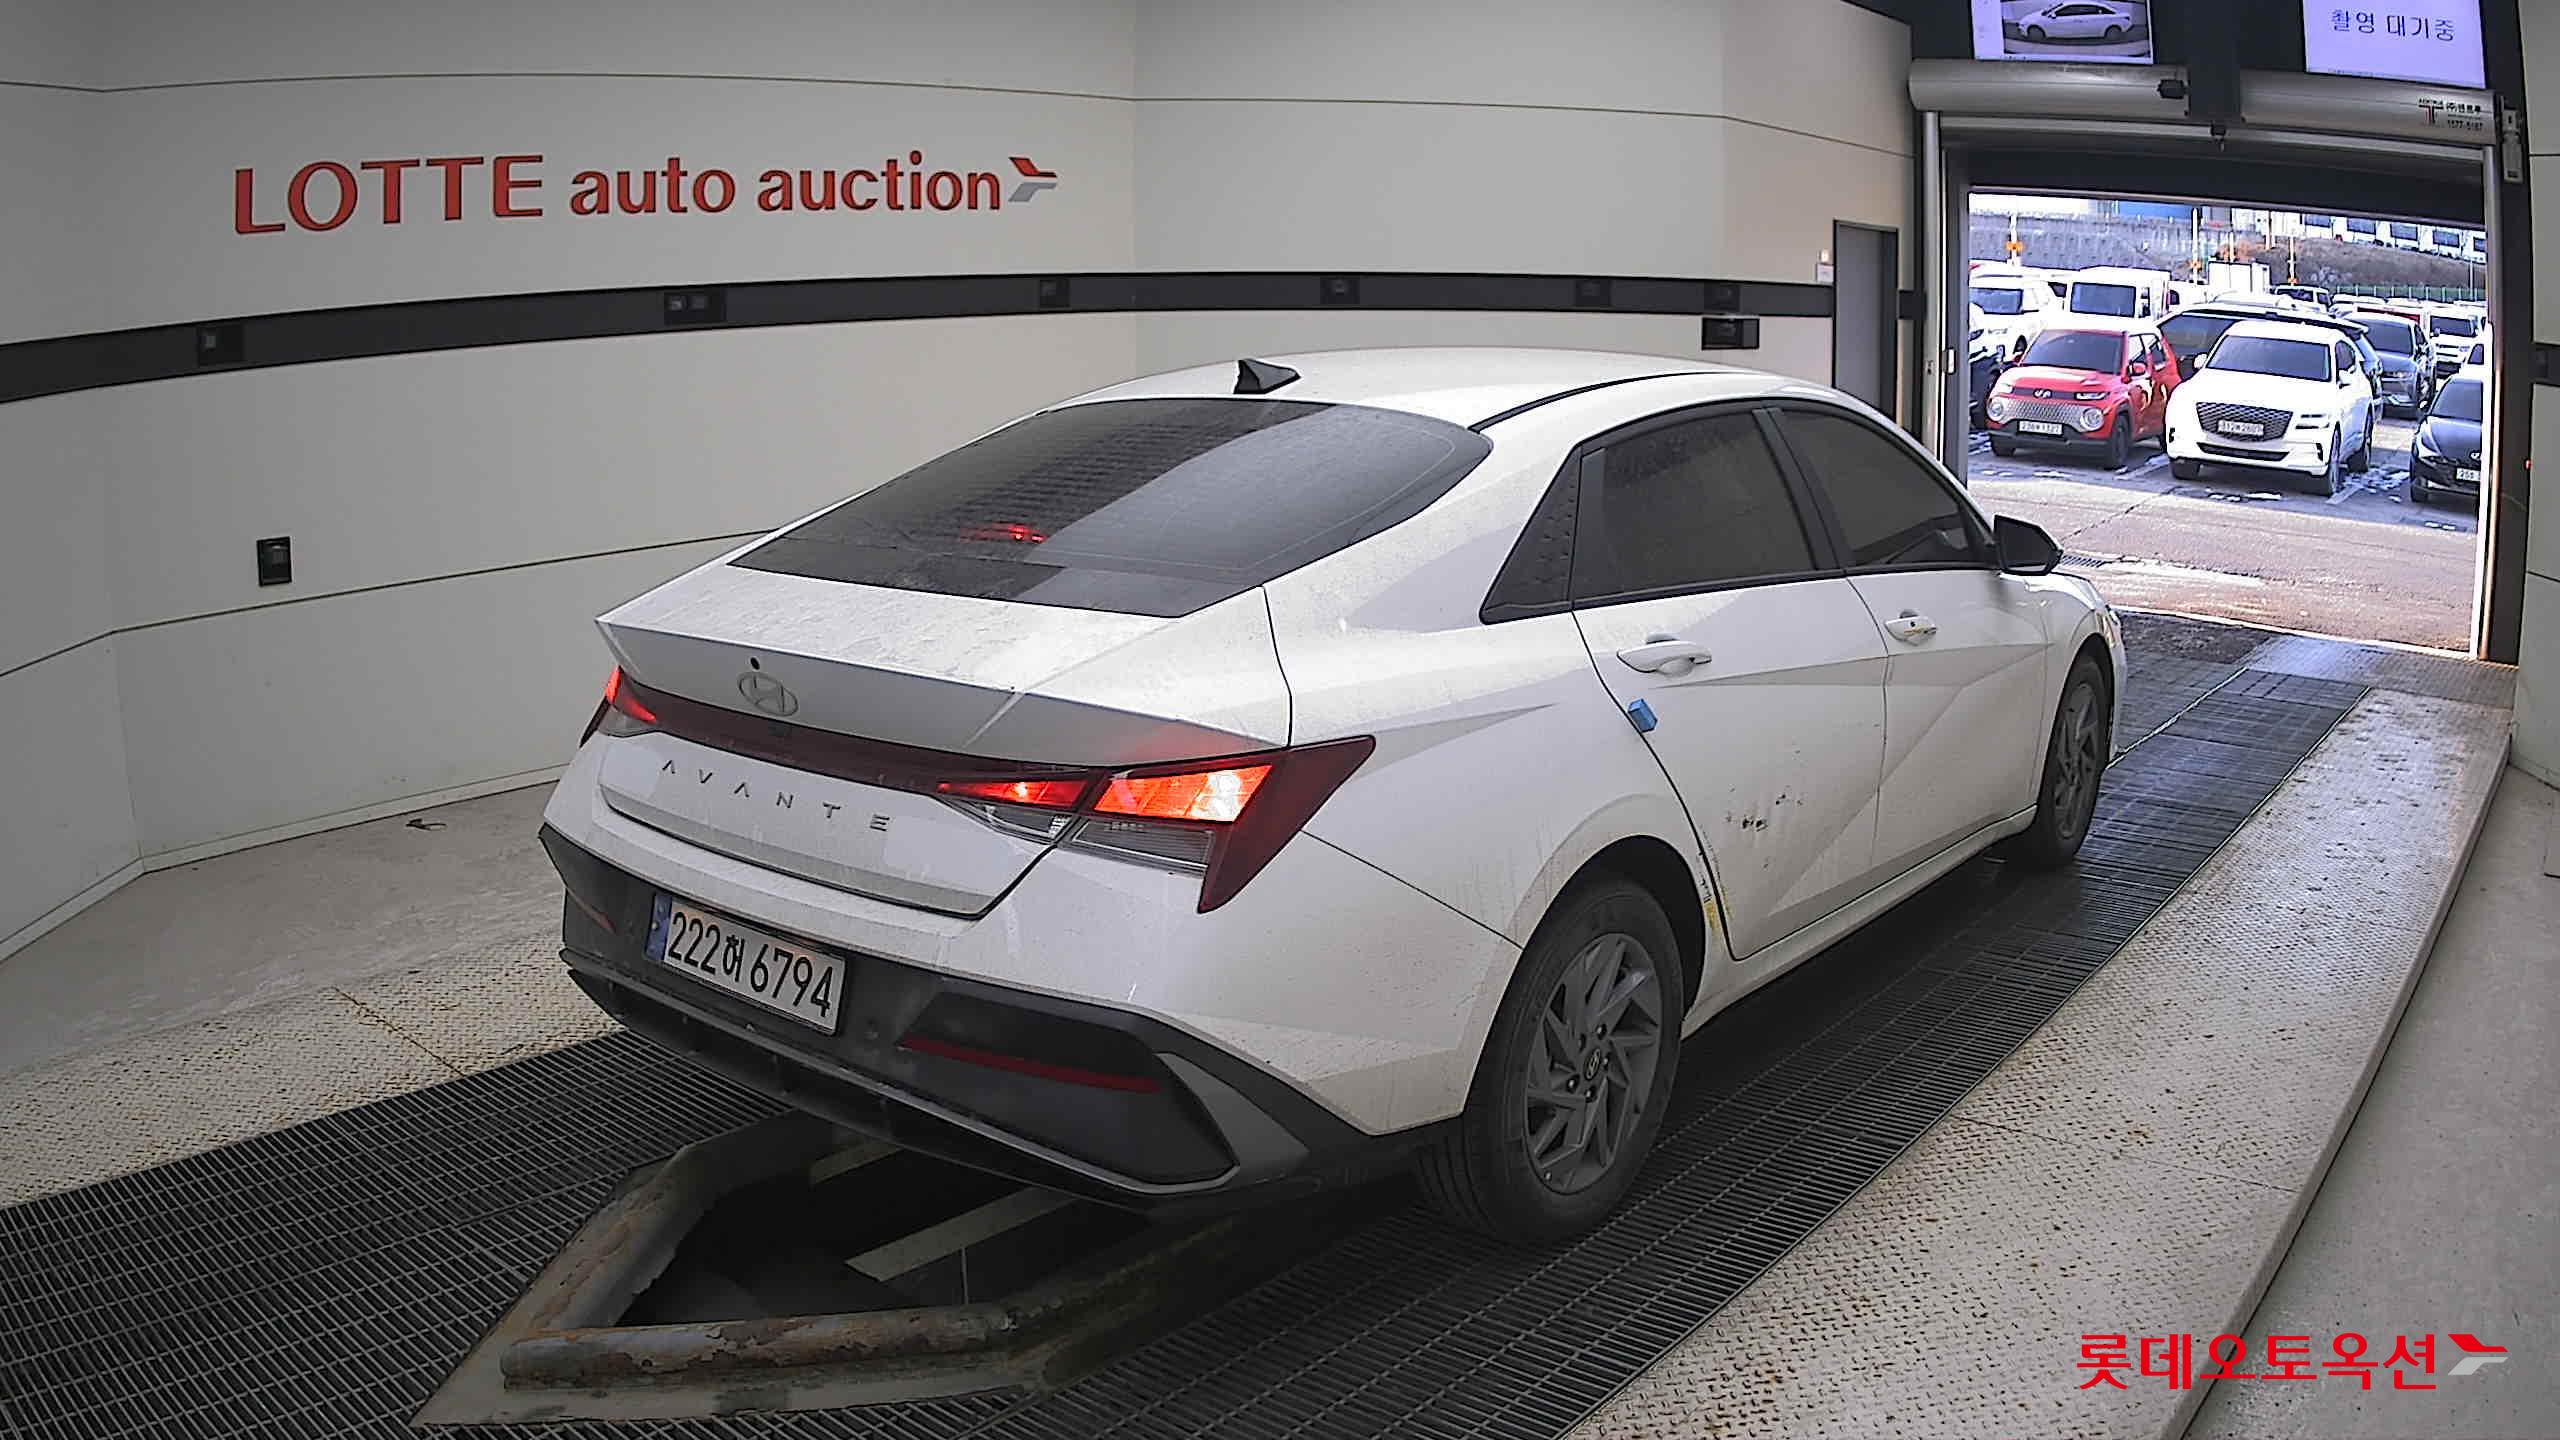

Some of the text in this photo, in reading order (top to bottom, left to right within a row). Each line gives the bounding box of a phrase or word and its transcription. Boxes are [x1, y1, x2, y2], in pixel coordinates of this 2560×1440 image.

[2330, 9, 2455, 41] 촬영 대기중
[234, 150, 1002, 236] LOTTE auto auction
[661, 759, 891, 833] AVANTE
